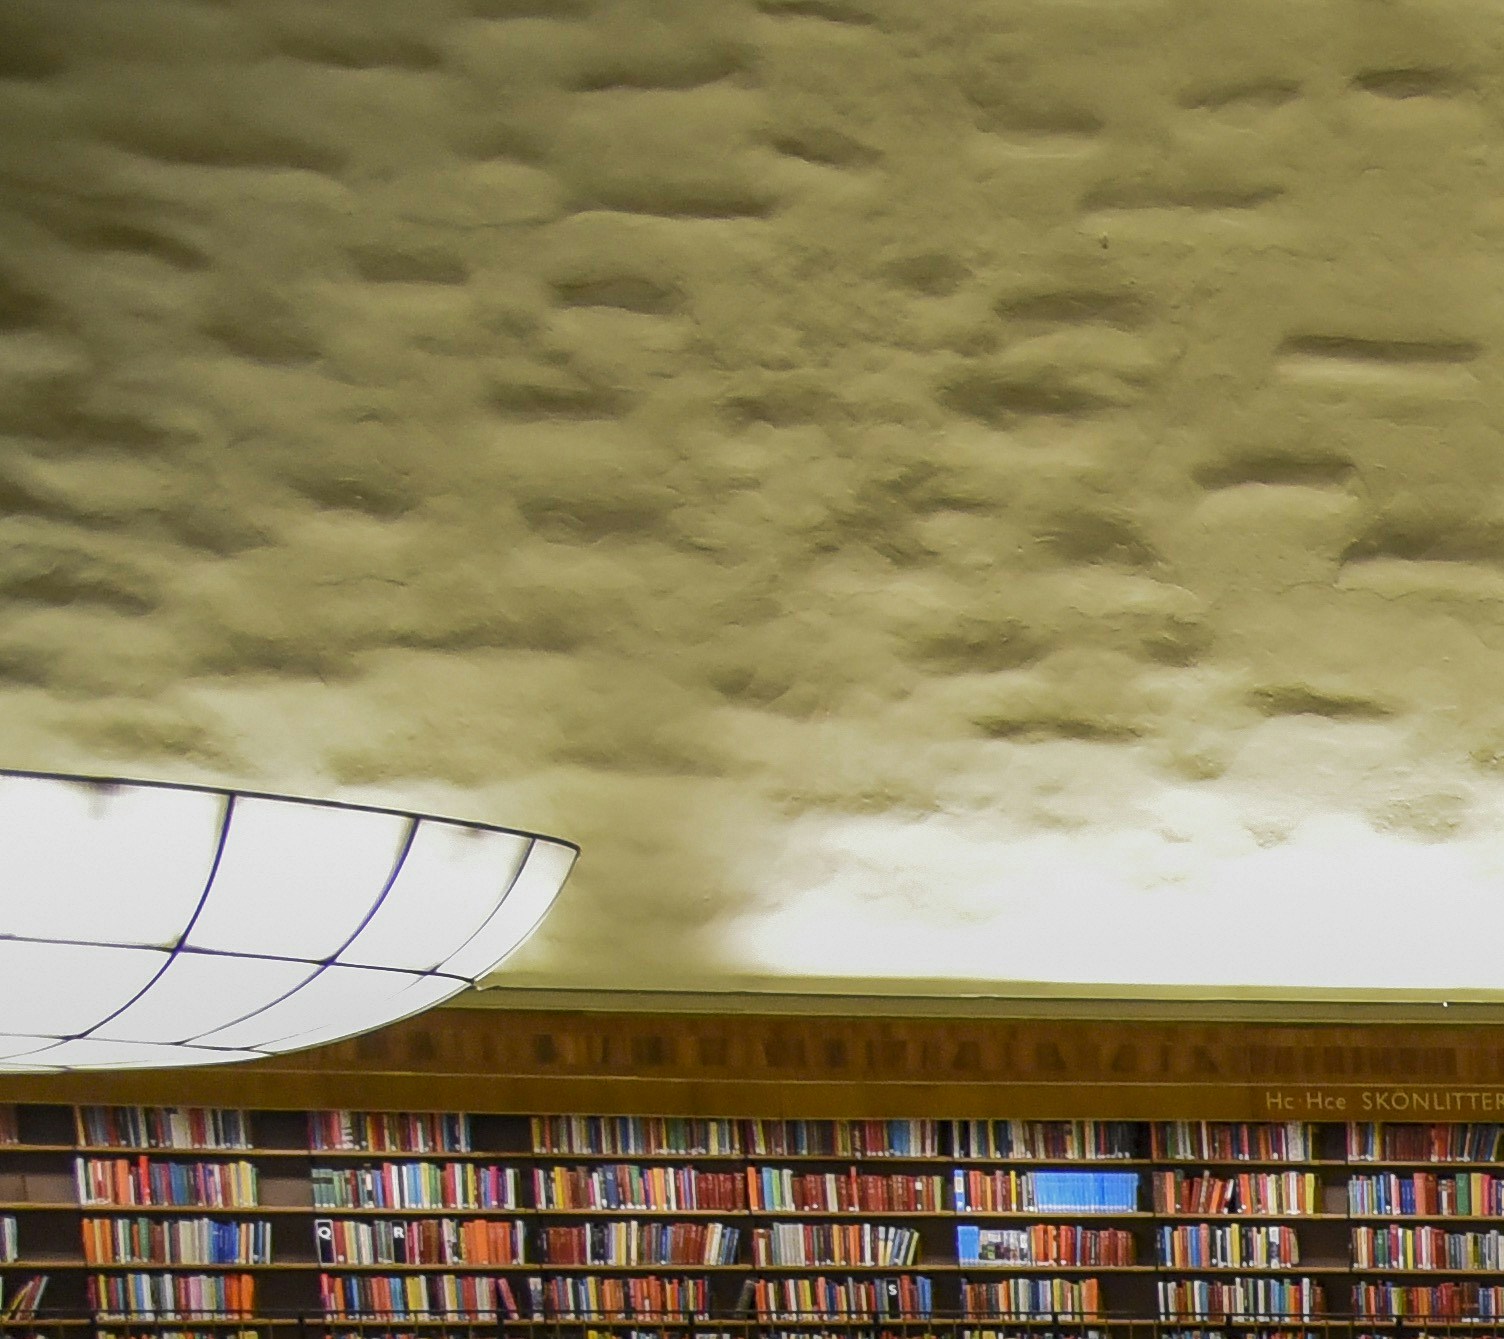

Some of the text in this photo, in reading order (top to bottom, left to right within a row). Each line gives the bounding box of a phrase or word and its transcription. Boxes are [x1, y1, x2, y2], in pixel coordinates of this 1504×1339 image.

[318, 1226, 332, 1240] Q
[394, 1227, 405, 1239] R
[888, 1285, 897, 1296] S
